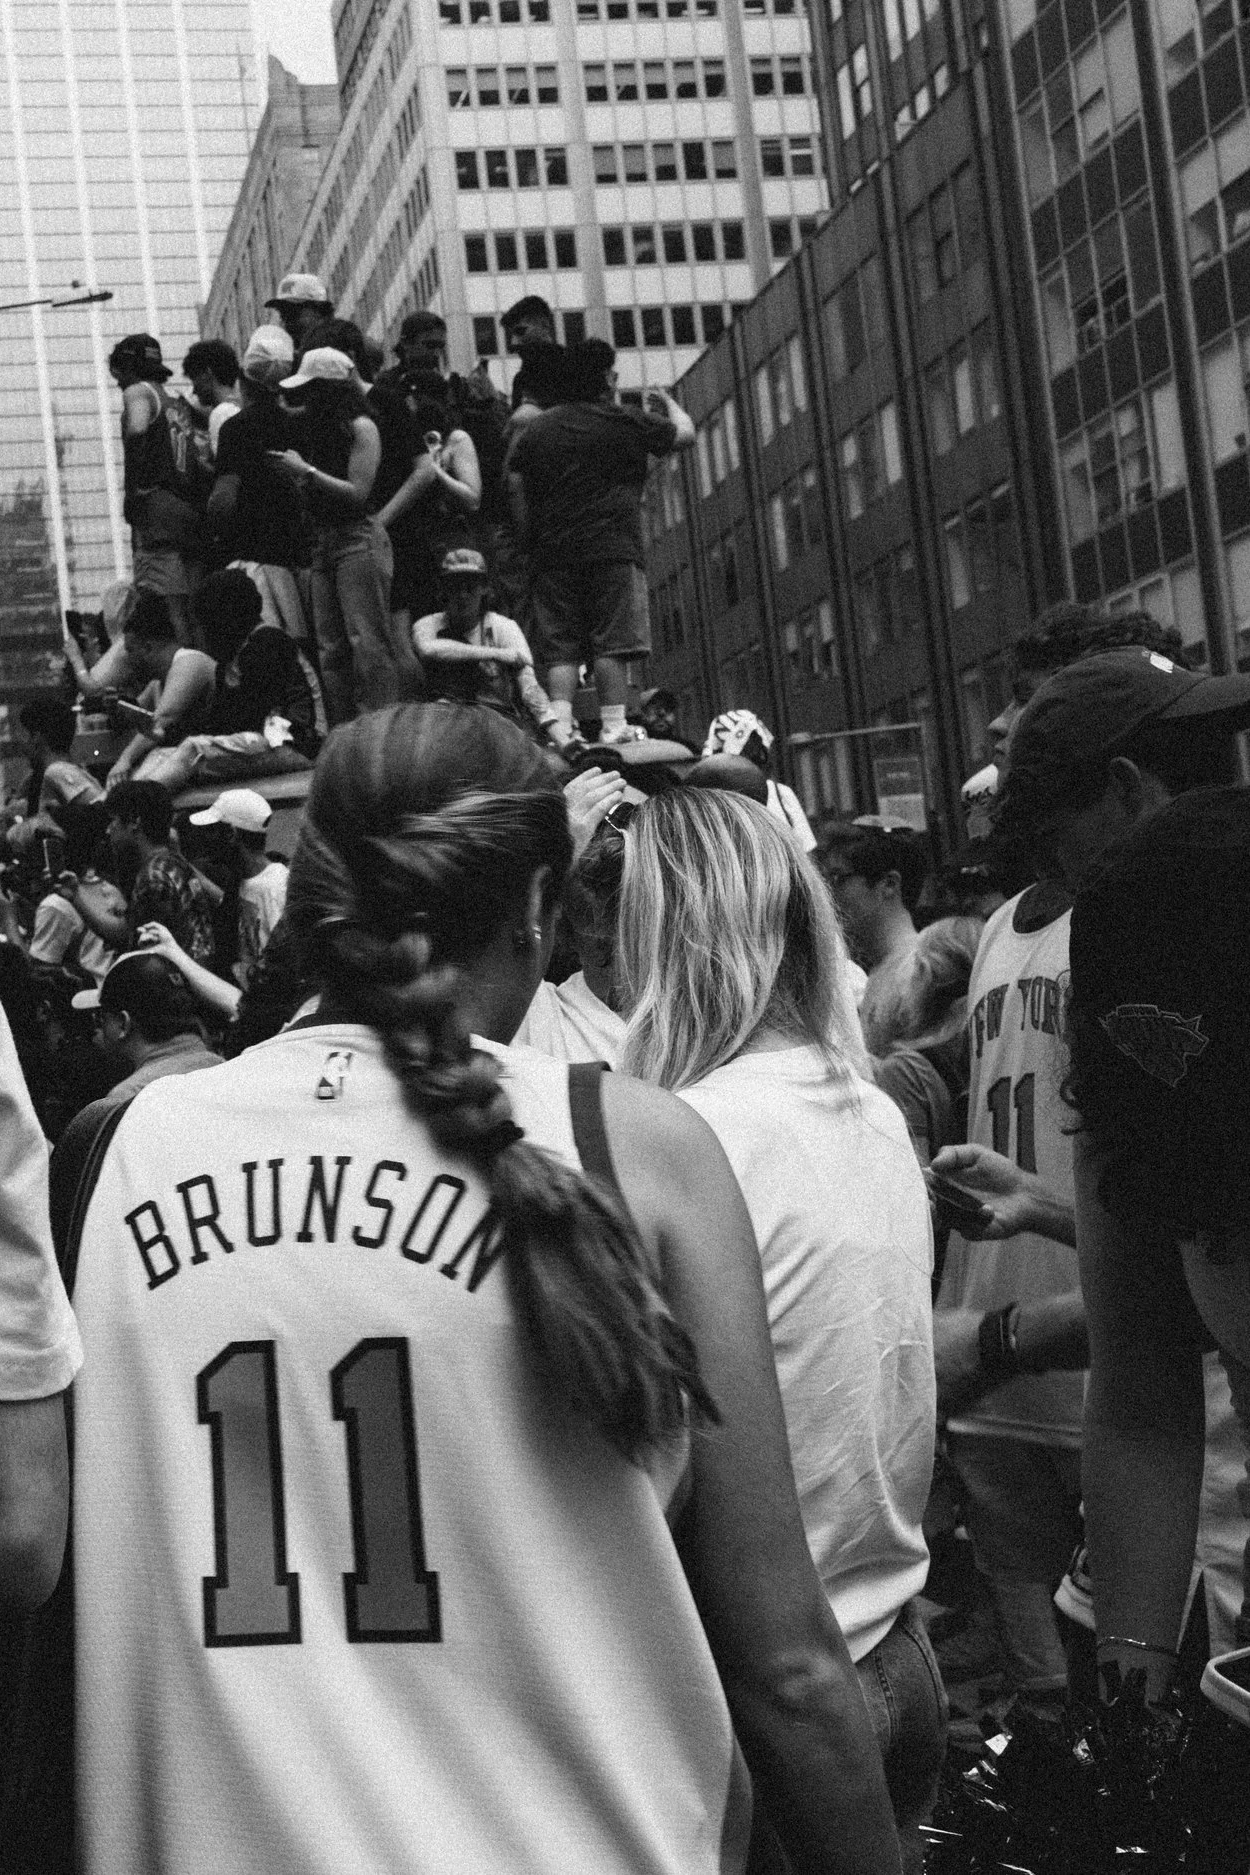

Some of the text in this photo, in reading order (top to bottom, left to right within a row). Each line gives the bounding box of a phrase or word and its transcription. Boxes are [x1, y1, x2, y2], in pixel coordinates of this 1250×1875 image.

[987, 1072, 1037, 1175] 11
[125, 1155, 507, 1293] BRUNSON
[196, 1337, 443, 1648] 11
